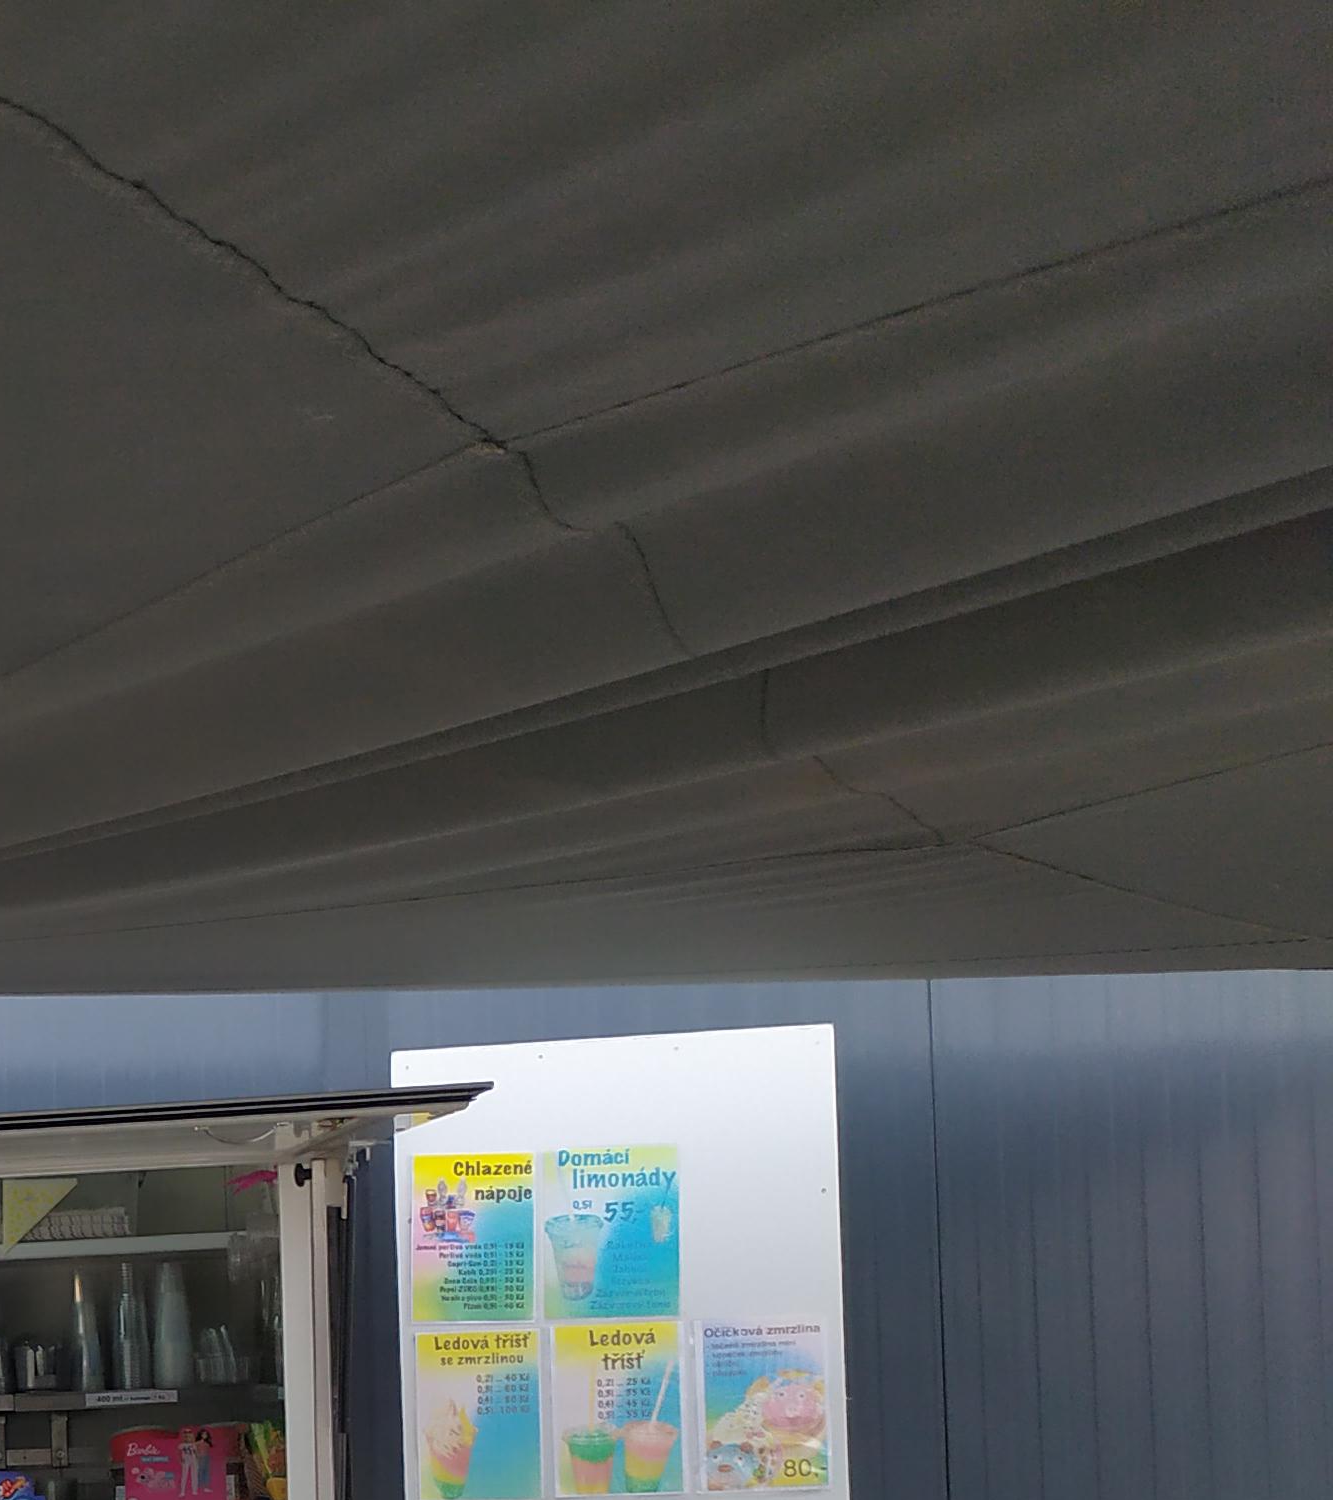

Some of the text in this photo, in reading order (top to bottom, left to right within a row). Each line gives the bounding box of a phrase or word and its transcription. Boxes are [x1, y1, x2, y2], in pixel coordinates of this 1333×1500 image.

[558, 1149, 630, 1168] Domácí
[453, 1161, 533, 1177] Chlazené
[572, 1167, 676, 1193] limonády
[474, 1186, 533, 1204] nápoje
[589, 1328, 656, 1347] Ledová
[767, 1323, 821, 1336] zmrzlina
[434, 1335, 489, 1350] Ledová
[440, 1353, 524, 1366] se zmrzlinou
[601, 1349, 646, 1371] tříšť
